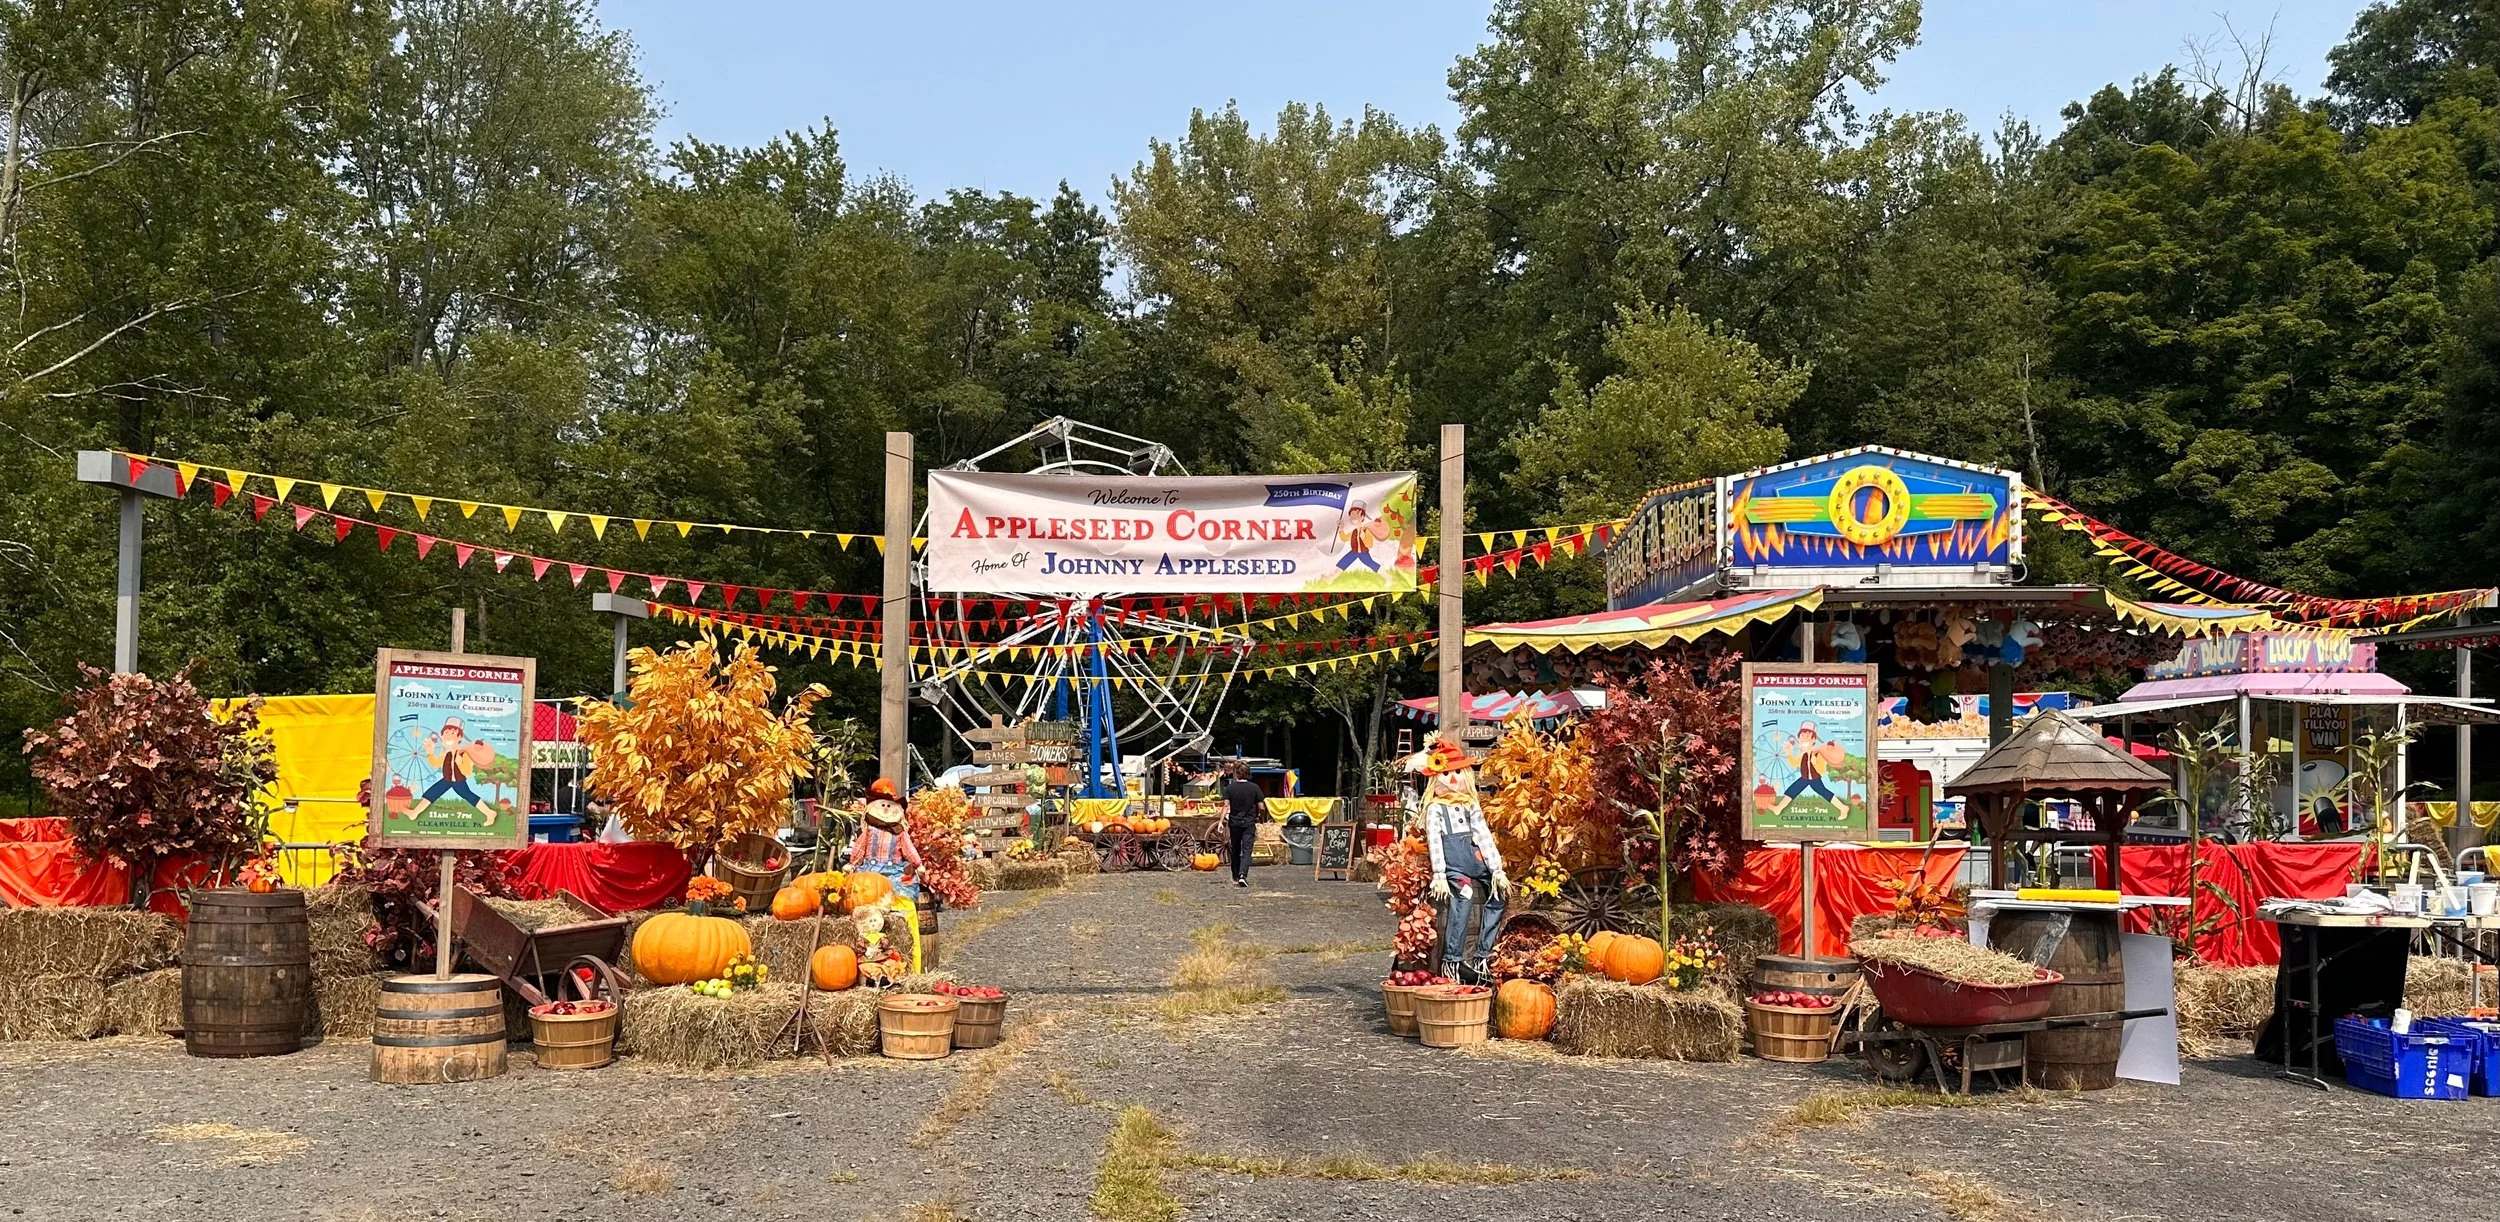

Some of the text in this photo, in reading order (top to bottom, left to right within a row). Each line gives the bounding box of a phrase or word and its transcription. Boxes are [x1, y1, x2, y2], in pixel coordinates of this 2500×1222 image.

[1088, 489, 1181, 508] Welcome To
[1273, 488, 1343, 500] 250TH BIRTHDAY
[951, 507, 1317, 542] APPLESEED CORNER
[972, 552, 1029, 575] Home Of
[1041, 552, 1297, 577] JOHNNY APPLESEED
[2200, 639, 2241, 668] DUCKY
[2268, 638, 2354, 664] LUCKY DUCKY
[394, 665, 519, 681] APPLESEED CORNER
[1755, 676, 1864, 686] APPLESEED CORNER
[396, 688, 441, 701] JOHNNY
[446, 690, 514, 704] APPLESEED'S
[1758, 697, 1859, 707] JOHNNY APPLESEED'S
[430, 702, 460, 711] BIRTHDAY
[461, 703, 504, 713] CELEBRATION
[2308, 705, 2341, 719] PLAY
[1467, 728, 1494, 737] APPLES
[2309, 731, 2341, 747] WIN
[984, 752, 1016, 761] GAMES
[1030, 745, 1068, 762] FLOWERS
[428, 810, 449, 819] 11AM
[456, 811, 472, 820] 7PM
[974, 816, 1017, 828] FLOWERS
[472, 820, 482, 828] PA
[2423, 1047, 2439, 1096] scenic
